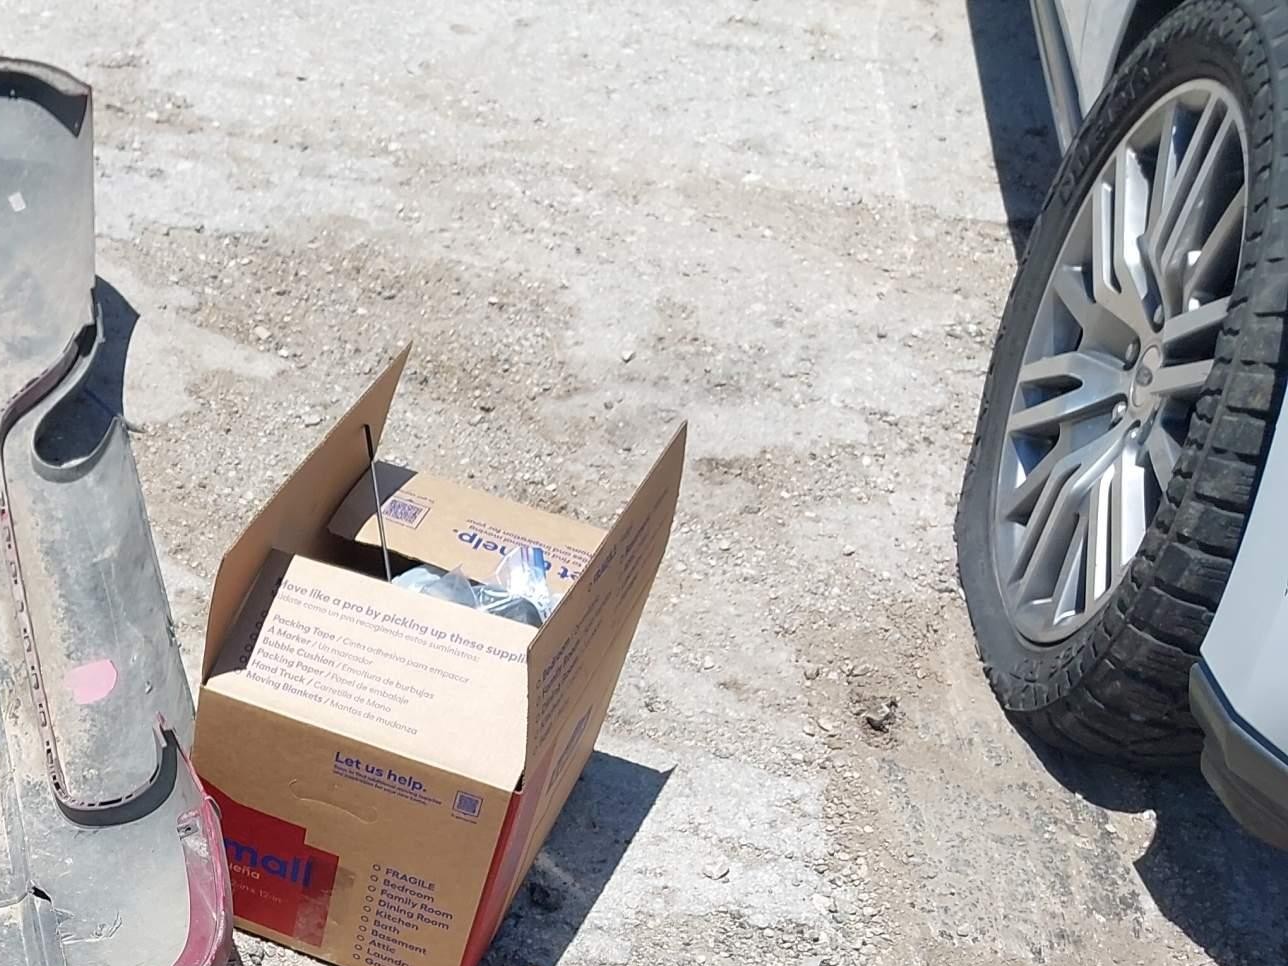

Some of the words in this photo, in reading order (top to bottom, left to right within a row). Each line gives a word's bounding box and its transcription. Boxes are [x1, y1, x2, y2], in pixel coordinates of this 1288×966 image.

[267, 625, 275, 634] A
[276, 628, 311, 645] Marker
[272, 614, 311, 634] Packing
[313, 627, 335, 640] Tape
[309, 588, 330, 602] like
[332, 598, 341, 606] a
[341, 601, 363, 613] pro
[365, 606, 381, 620] by
[381, 614, 429, 635] picking
[430, 628, 447, 640] up
[450, 633, 484, 651] these
[486, 646, 528, 663] suppli
[257, 647, 295, 668] Packing
[295, 661, 325, 676] Paper
[262, 636, 295, 654] Bubble
[296, 648, 335, 667] Cushion
[251, 658, 278, 674] Hand
[280, 668, 306, 684] Truck
[246, 670, 281, 690] Moving
[282, 682, 323, 703] Blankets
[375, 716, 418, 735] mudanza
[335, 751, 361, 770] Let
[364, 764, 385, 778] us
[387, 769, 427, 793] help.
[224, 838, 312, 888] mall
[383, 878, 434, 903] Bedroom
[385, 868, 435, 891] FRAGILE
[378, 899, 414, 919] Dining
[416, 913, 449, 930] Room
[380, 889, 418, 908] Family
[420, 903, 453, 920] Room
[373, 919, 400, 935] Bath
[375, 909, 419, 931] Kitchen
[371, 929, 426, 955] Basement
